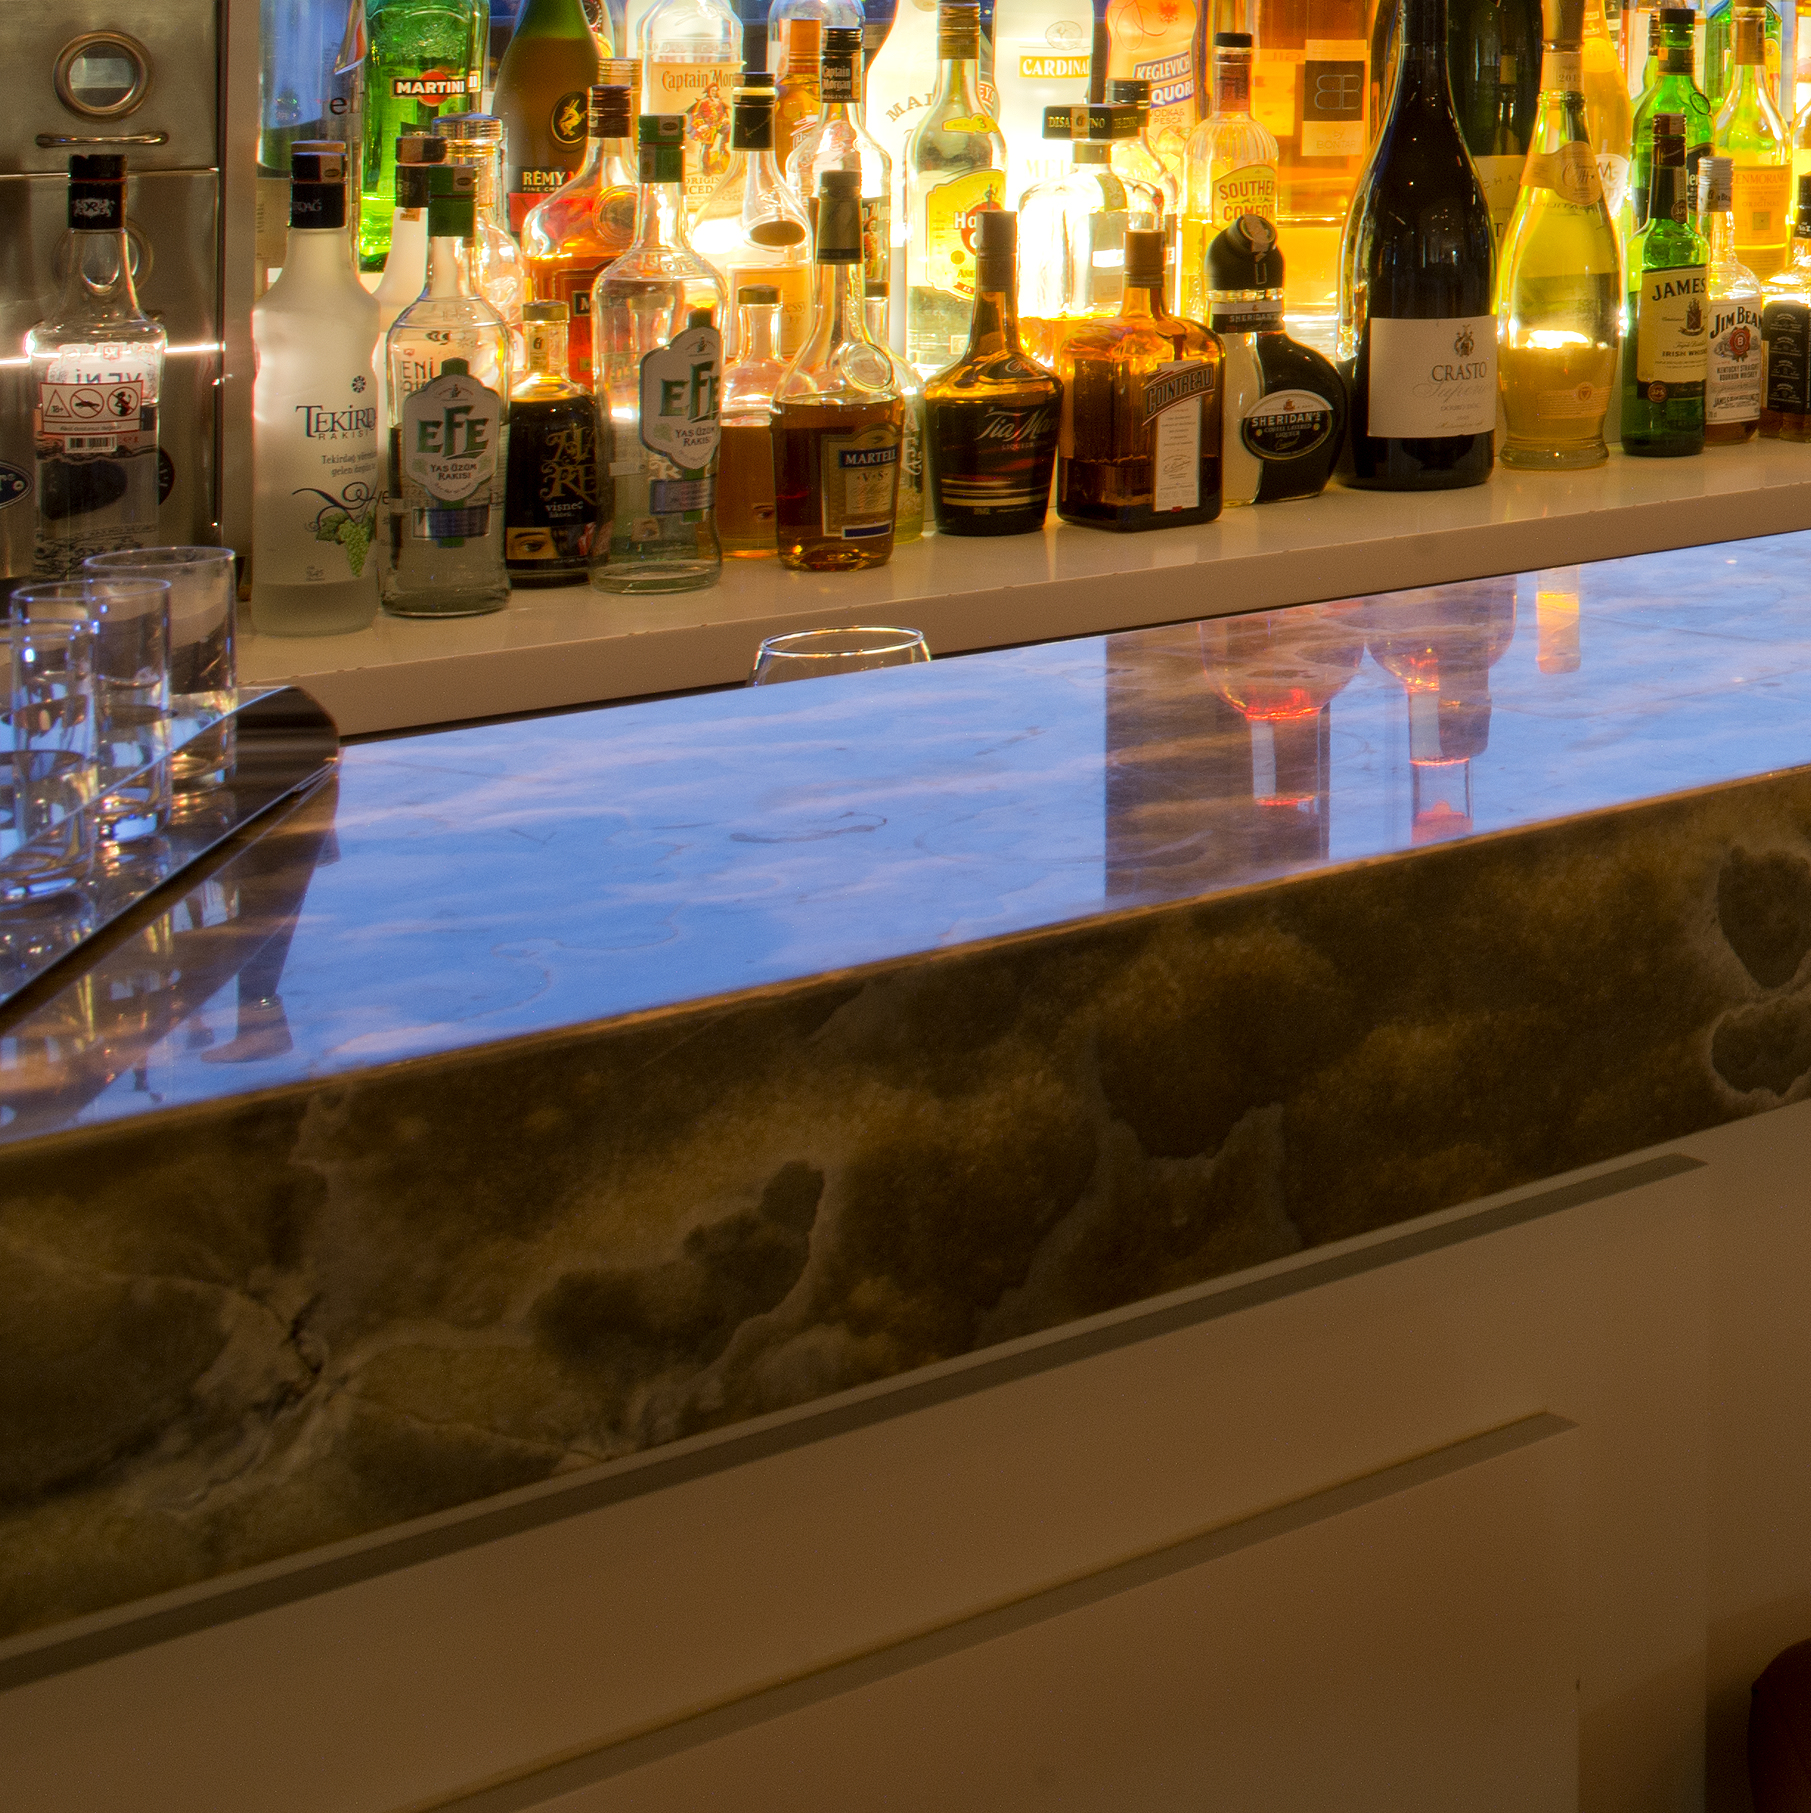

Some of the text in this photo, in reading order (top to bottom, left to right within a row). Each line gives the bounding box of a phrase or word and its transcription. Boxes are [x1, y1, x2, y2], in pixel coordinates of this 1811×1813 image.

[396, 80, 466, 94] MARTINI
[661, 70, 708, 92] Captain
[522, 170, 566, 186] RÉMY
[1709, 311, 1735, 340] JIM
[1431, 361, 1487, 382] CRASTO
[1146, 366, 1214, 416] COINTREAU
[1250, 412, 1322, 428] SHERIDAN'S
[416, 405, 490, 461] EFE
[844, 448, 897, 466] MARTELL
